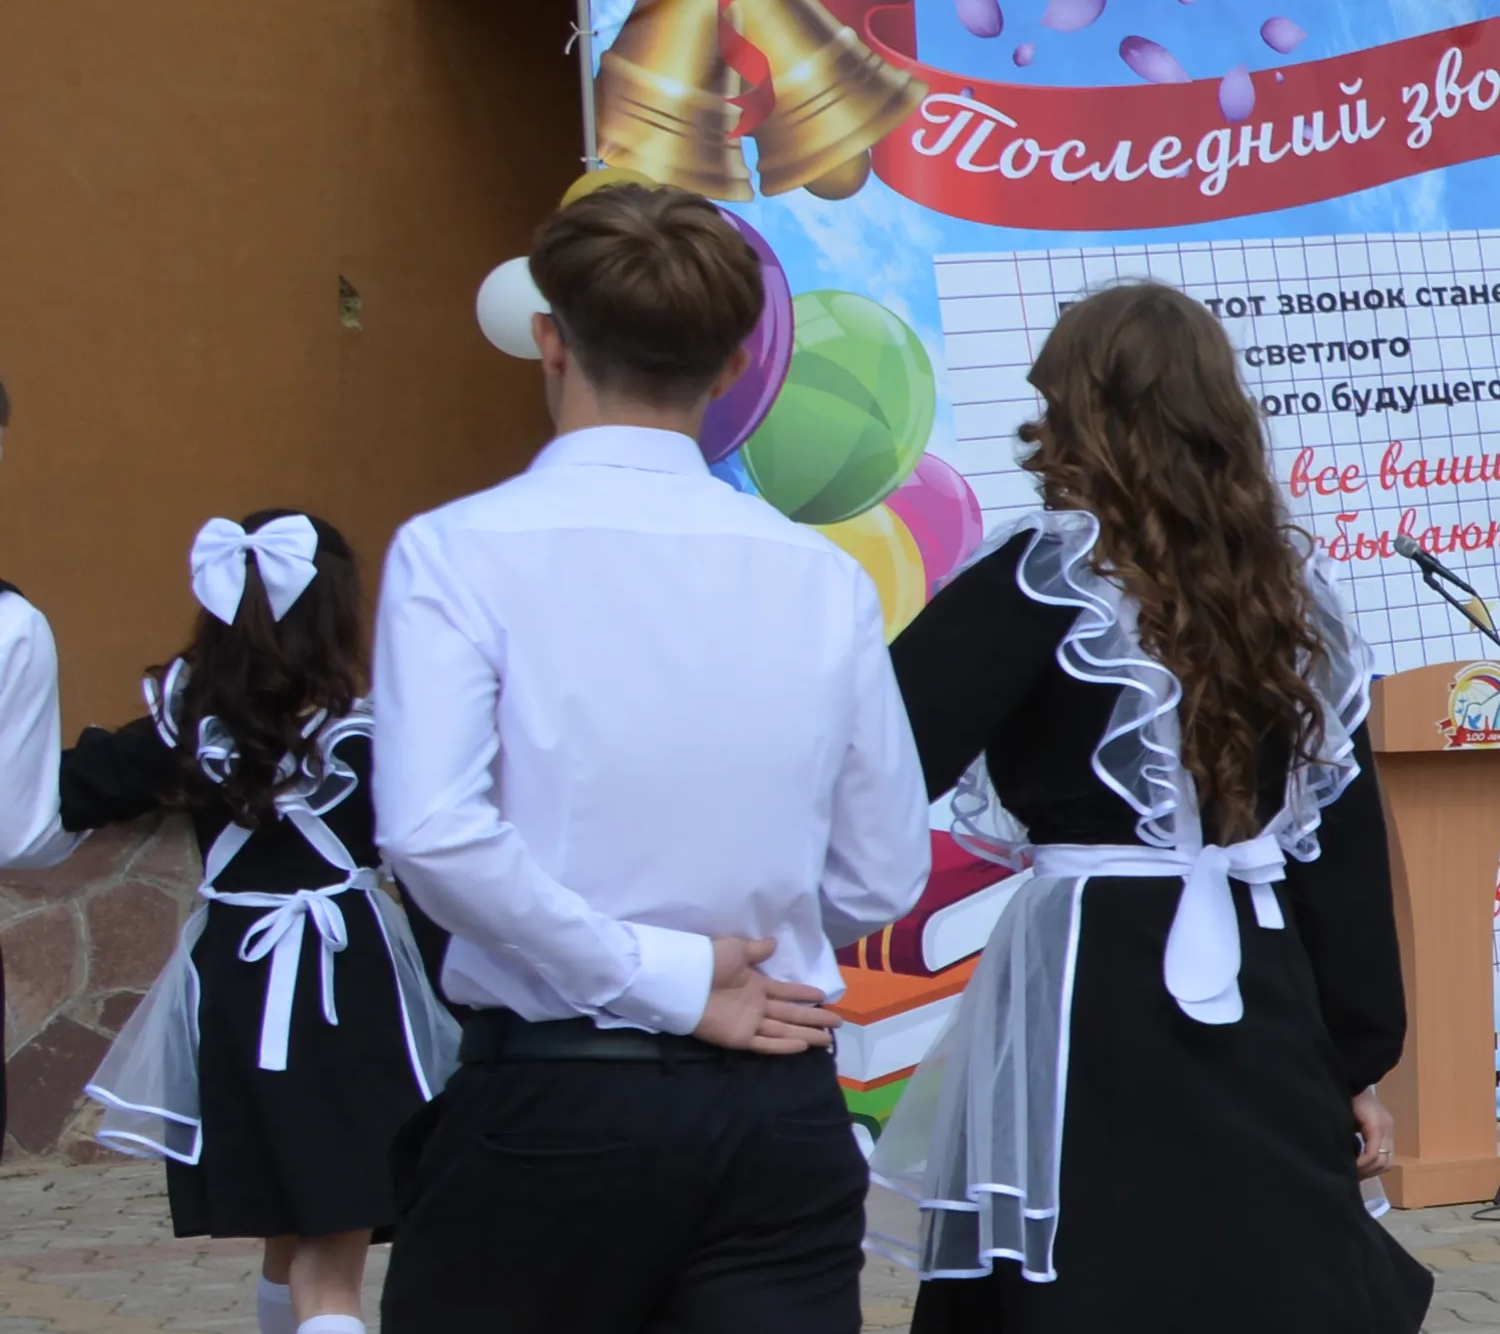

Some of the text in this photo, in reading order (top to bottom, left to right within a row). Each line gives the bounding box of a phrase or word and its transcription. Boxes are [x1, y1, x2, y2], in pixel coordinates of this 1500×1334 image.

[911, 76, 1387, 196] Последний
[1204, 294, 1266, 320] тот
[1278, 286, 1407, 316] звонок
[1244, 336, 1411, 368] светлого
[1261, 392, 1322, 417] ого
[1290, 446, 1367, 499] все
[1466, 733, 1485, 742] 100
